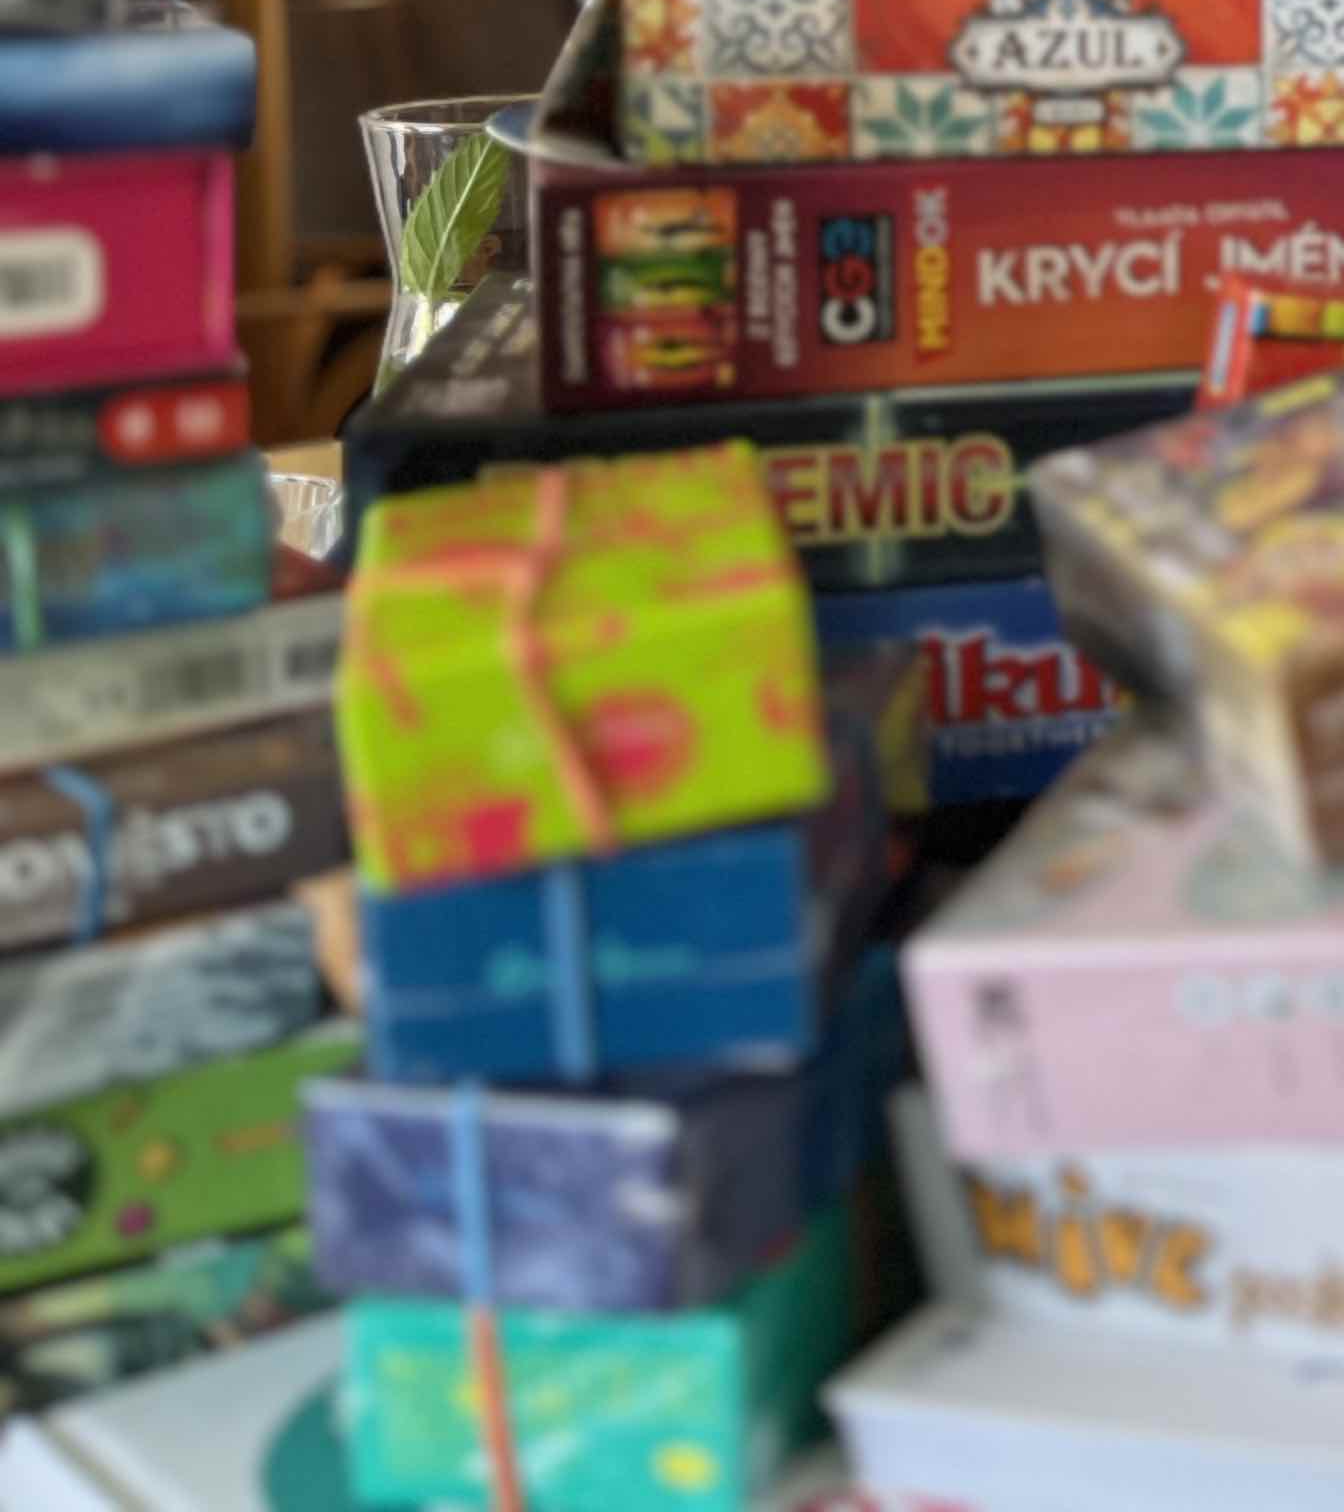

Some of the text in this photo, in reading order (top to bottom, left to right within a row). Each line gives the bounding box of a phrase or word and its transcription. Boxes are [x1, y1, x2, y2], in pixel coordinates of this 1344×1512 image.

[991, 27, 1143, 70] AZUL
[976, 226, 1184, 306] KRYCÍ
[764, 434, 1013, 538] EMIC
